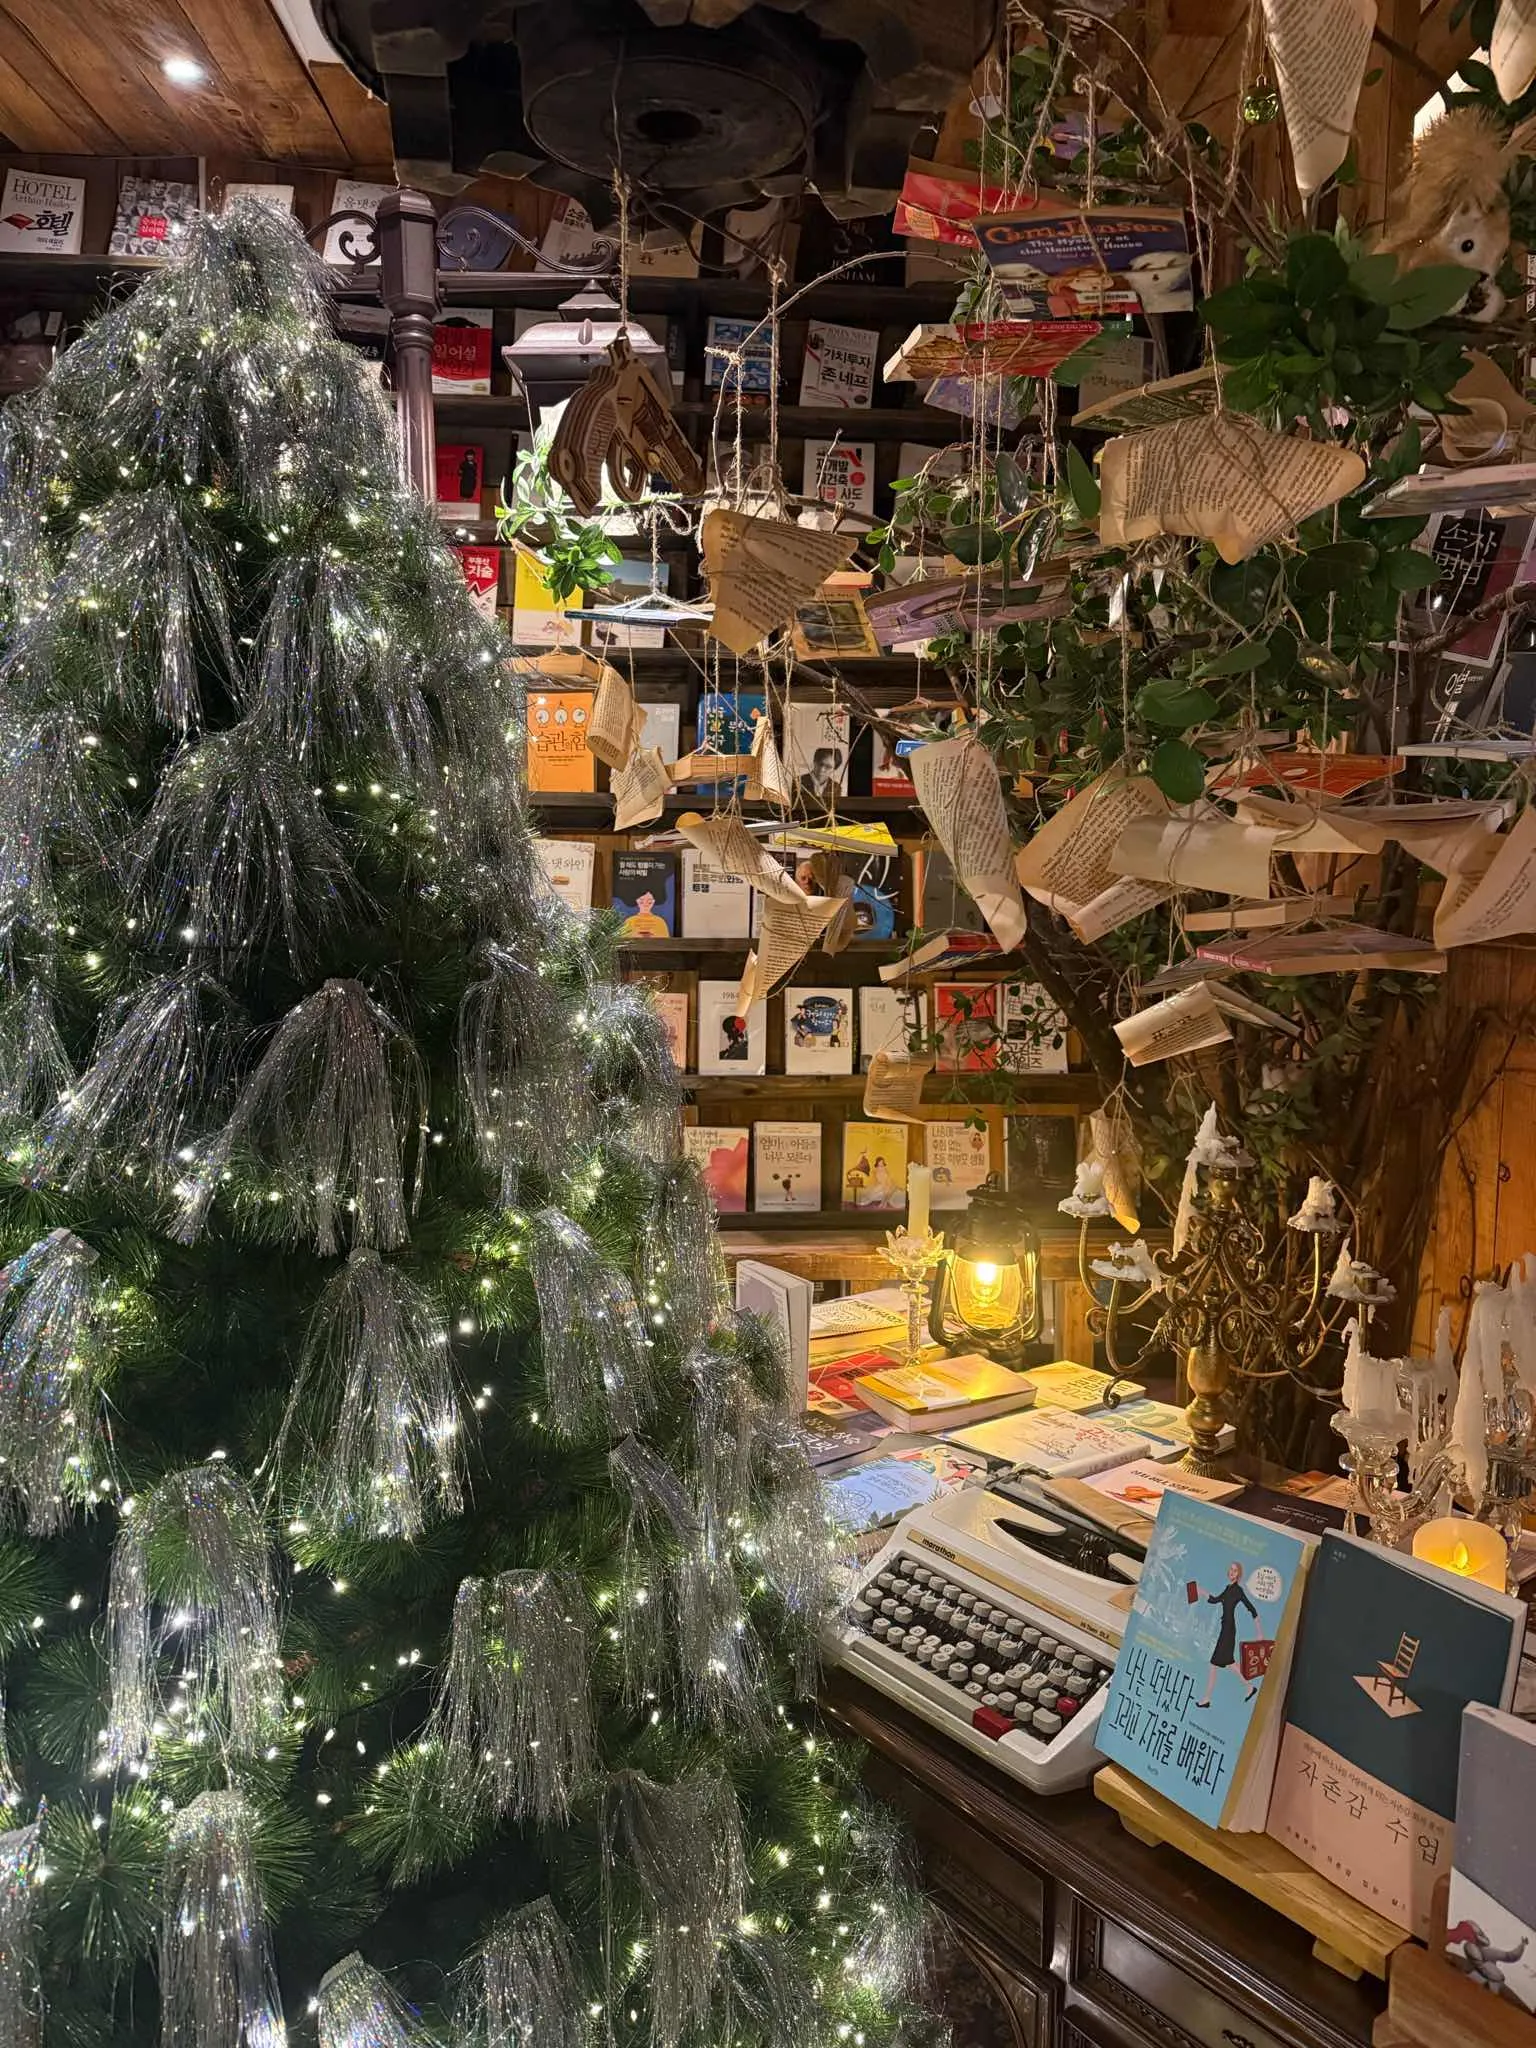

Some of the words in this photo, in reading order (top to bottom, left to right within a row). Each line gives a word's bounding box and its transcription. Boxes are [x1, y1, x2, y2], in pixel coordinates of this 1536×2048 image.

[14, 178, 76, 201] HOTEL
[26, 210, 74, 236] 호텔
[1020, 247, 1043, 256] the
[1103, 240, 1144, 250] House
[1029, 240, 1054, 248] The
[433, 343, 476, 360] 일어설
[824, 347, 871, 369] 가치투자
[821, 366, 837, 382] 존
[839, 371, 870, 389] 네프
[816, 458, 849, 473] 재개발
[816, 472, 849, 487] 재건축
[840, 487, 863, 500] 사도
[1440, 522, 1498, 557] 손자
[1434, 550, 1485, 586] 병법
[922, 1537, 956, 1561] marathon
[1125, 1646, 1149, 1698] 나는
[1150, 1658, 1196, 1723] 떠났다
[1107, 1692, 1142, 1742] 그리고
[1139, 1709, 1178, 1767] 자유를
[1176, 1730, 1226, 1796] 배웠다
[1298, 1759, 1368, 1820] 자존감
[1385, 1817, 1440, 1867] 수업
